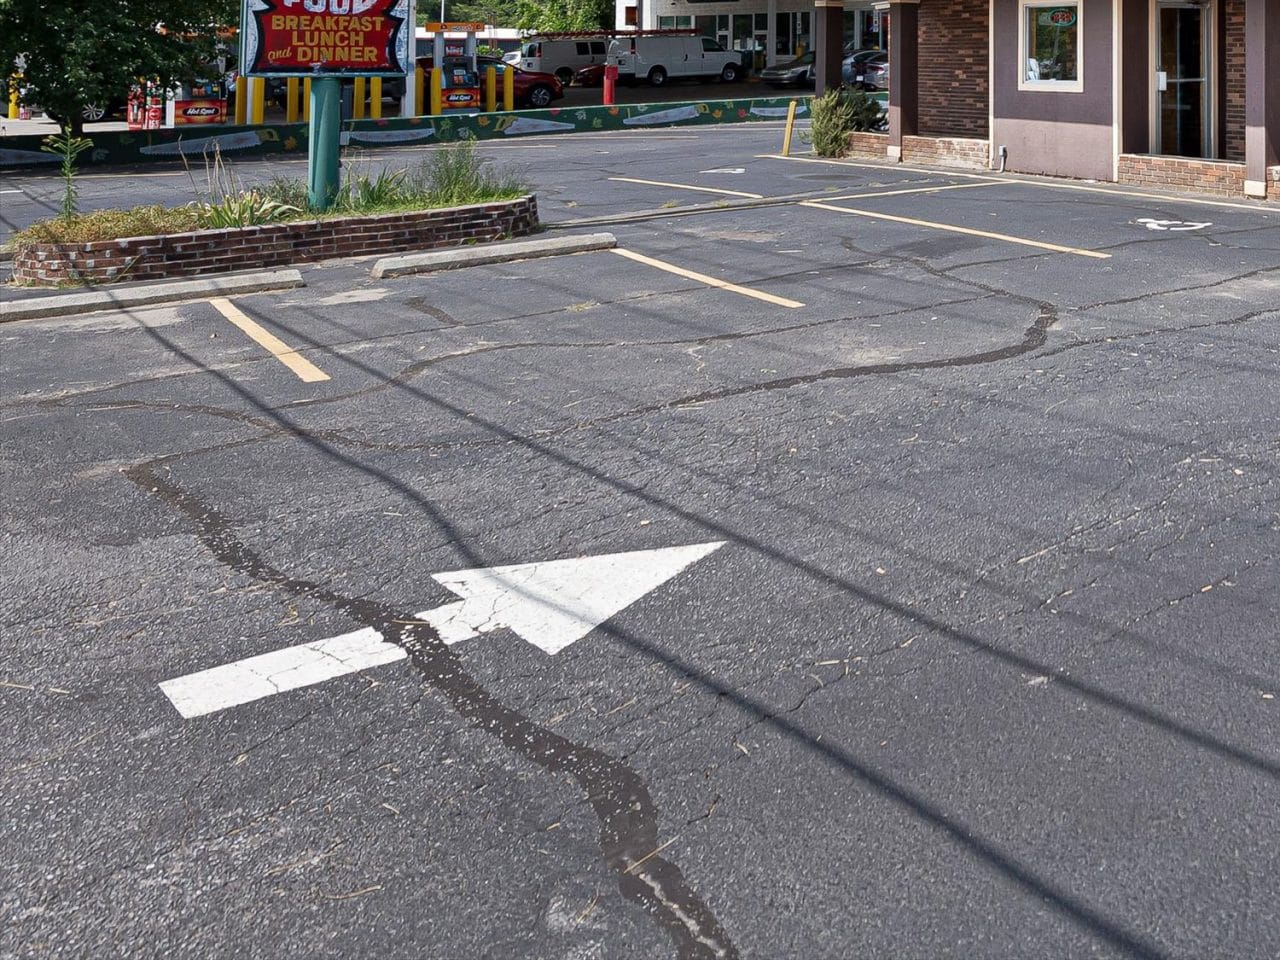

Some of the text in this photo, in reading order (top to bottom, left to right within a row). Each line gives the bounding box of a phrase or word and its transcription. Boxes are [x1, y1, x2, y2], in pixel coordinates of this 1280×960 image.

[271, 15, 384, 31] BREAKFAST
[291, 31, 364, 46] LUNCH
[267, 46, 378, 62] and DINNER
